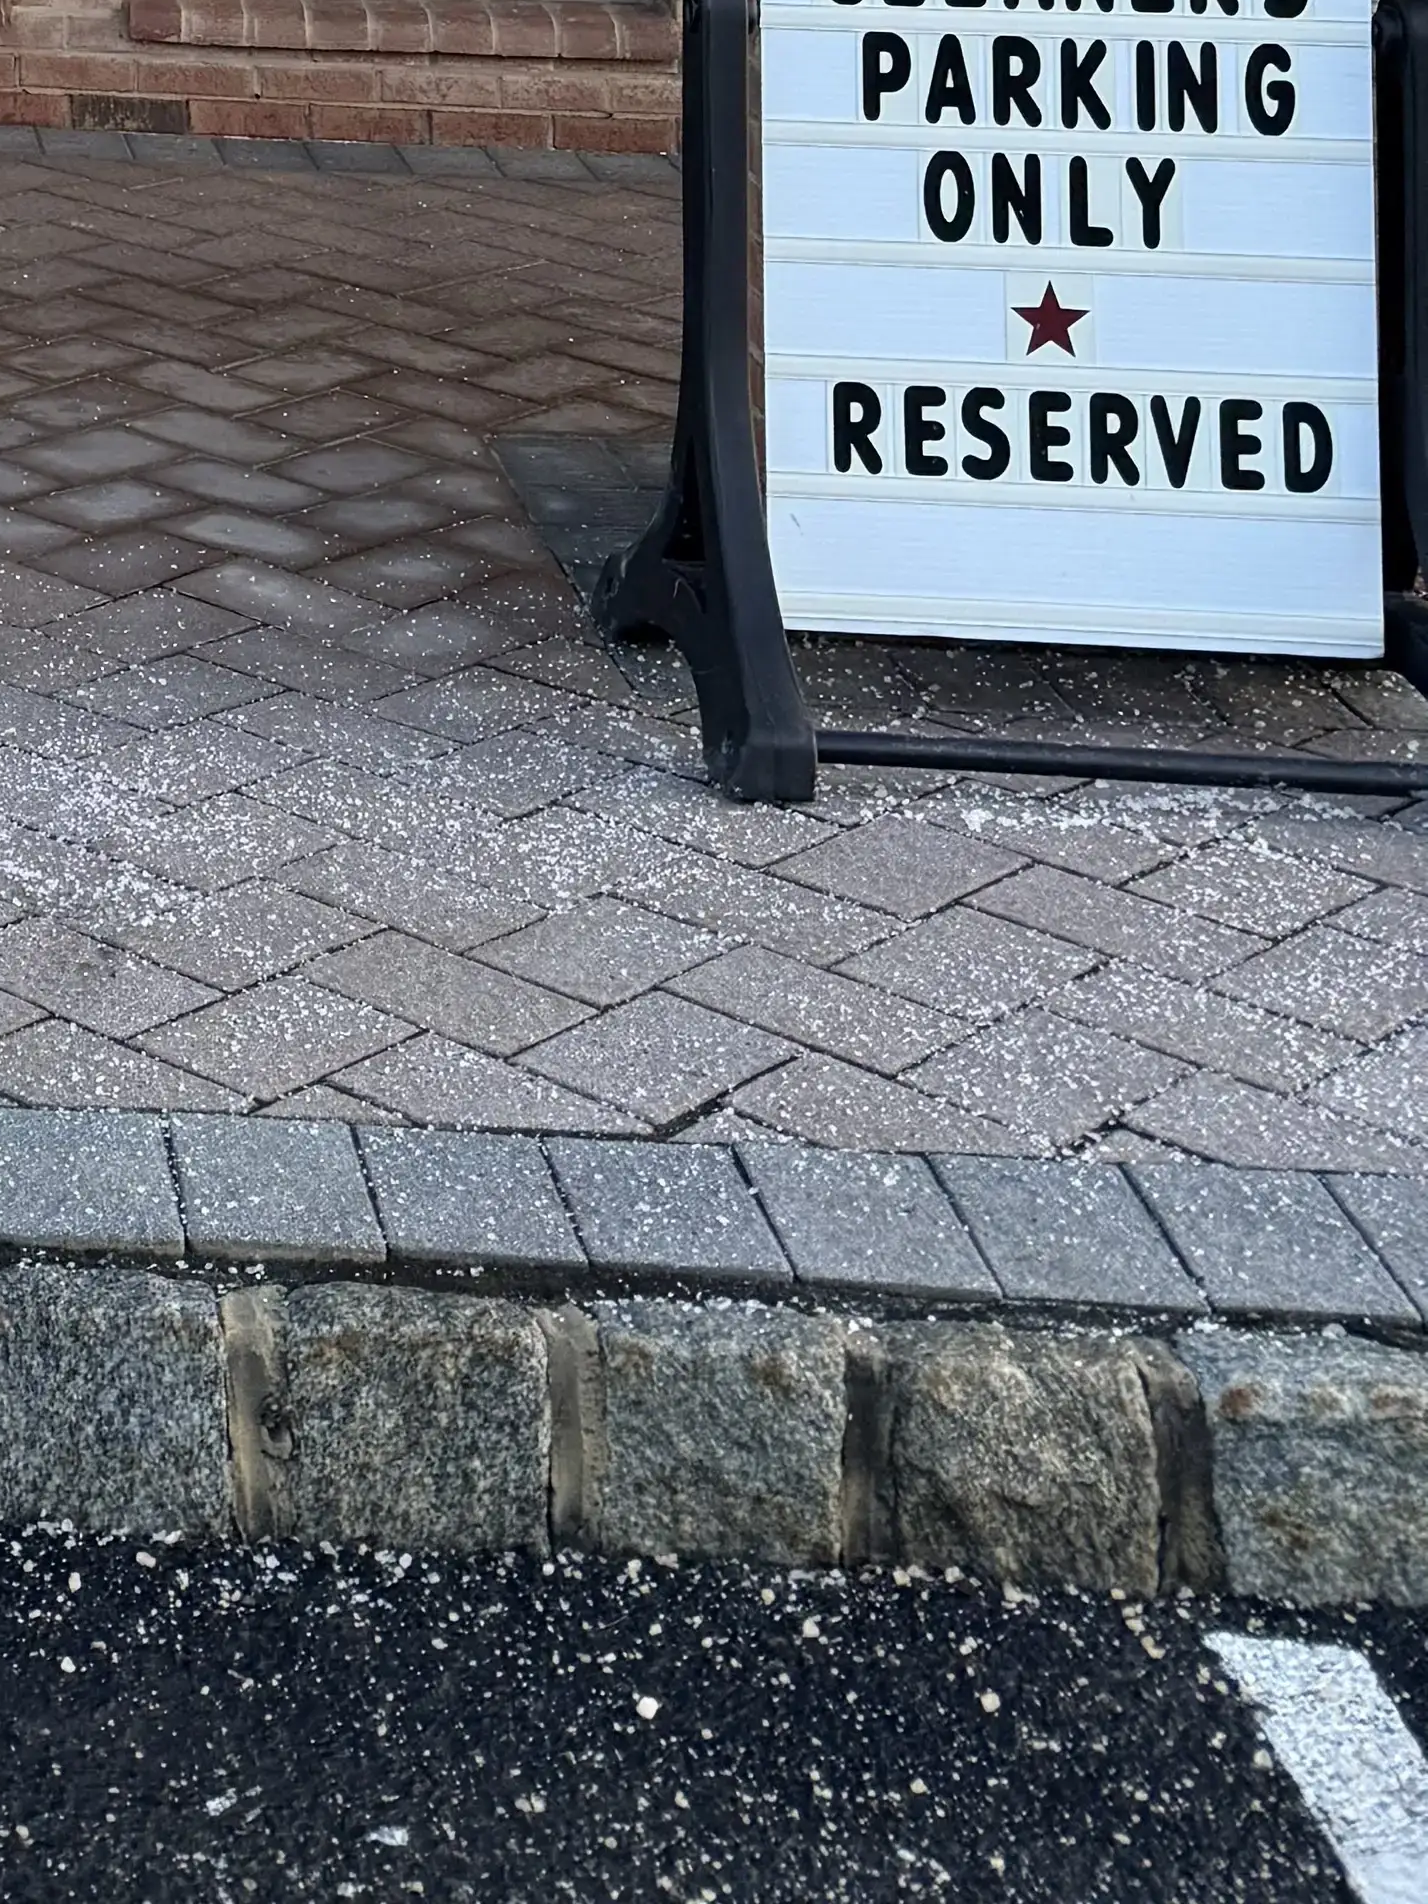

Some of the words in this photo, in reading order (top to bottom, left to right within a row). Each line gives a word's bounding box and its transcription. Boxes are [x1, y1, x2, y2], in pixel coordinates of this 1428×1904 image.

[860, 31, 1297, 138] PARKING
[922, 149, 1177, 251] ONLY
[831, 380, 1336, 494] RESERVED
